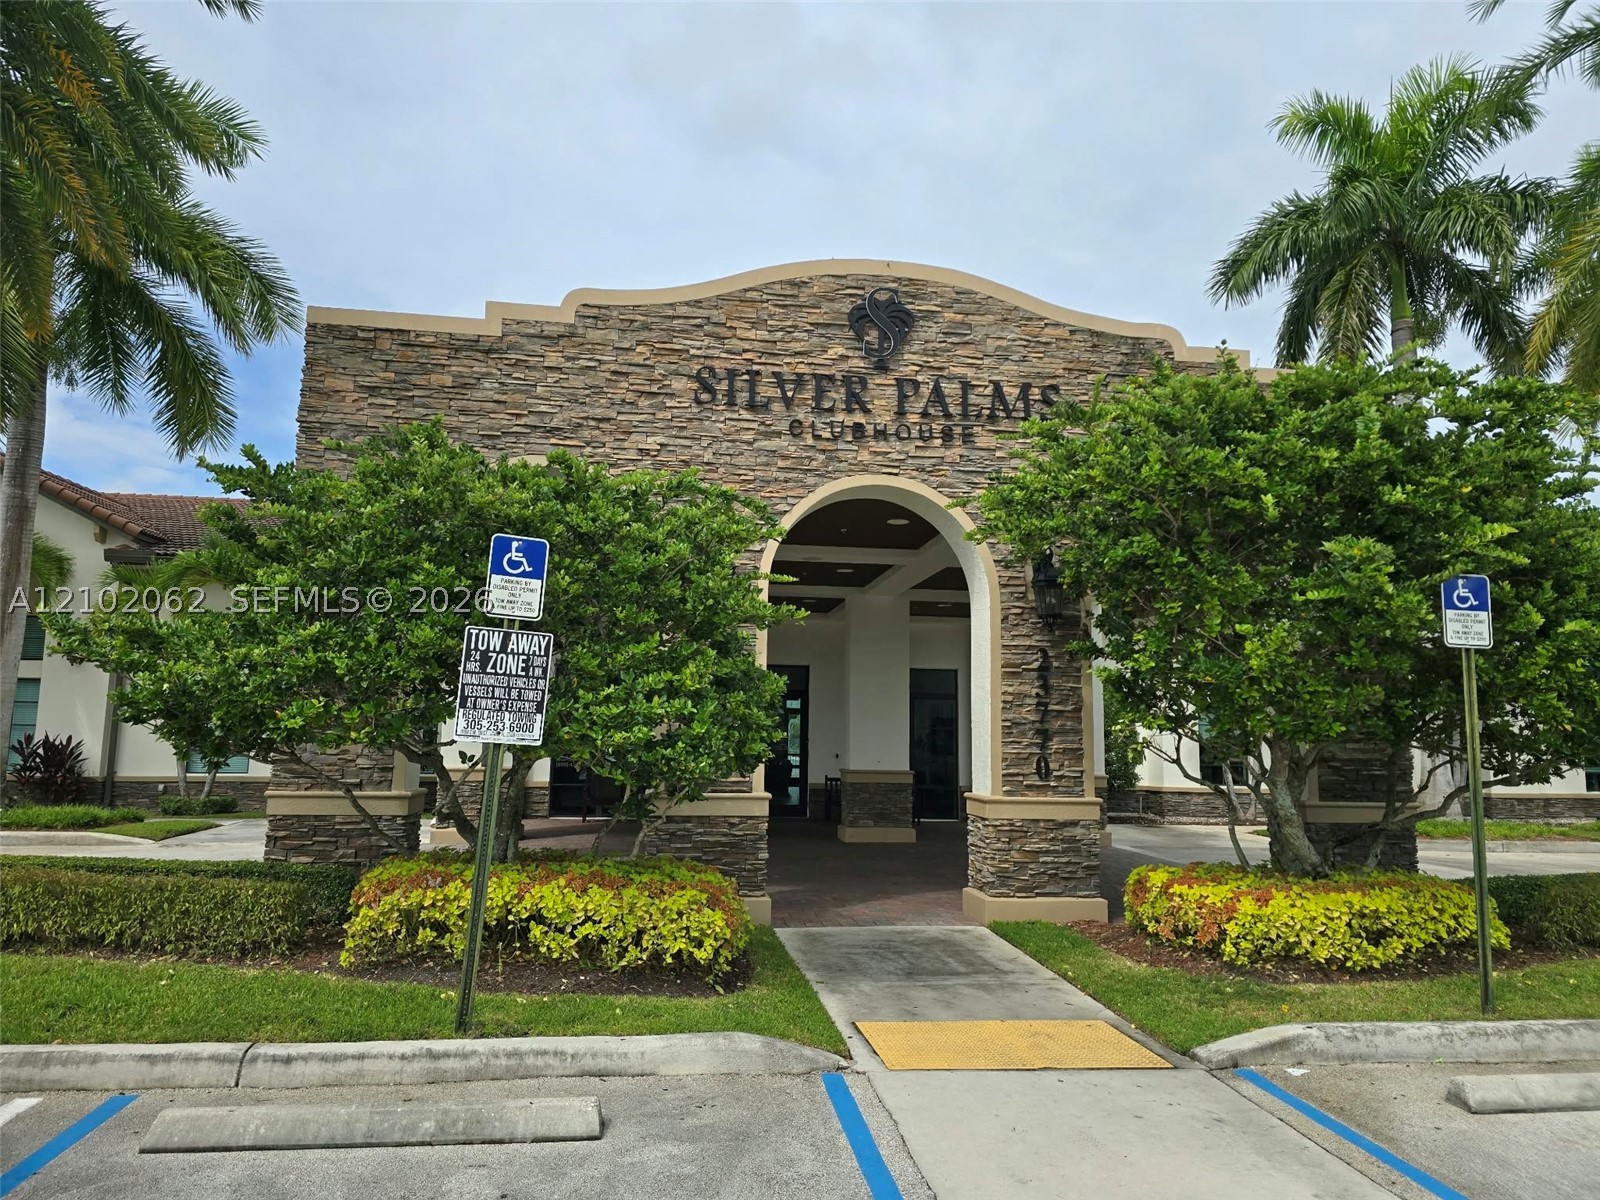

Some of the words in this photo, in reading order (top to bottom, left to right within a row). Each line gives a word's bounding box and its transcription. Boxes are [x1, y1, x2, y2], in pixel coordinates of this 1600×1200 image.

[694, 365, 872, 412] SILVER
[894, 375, 1061, 421] PALMS
[788, 418, 975, 443] CLUBHOUSE
[493, 584, 518, 592] DISABLED
[501, 578, 523, 586] PARKING
[470, 629, 503, 652] TOW
[507, 633, 549, 656] AWAY
[470, 650, 480, 661] 24
[529, 655, 533, 666] 7
[533, 656, 547, 667] DAYS
[466, 661, 481, 673] HRS.
[486, 652, 527, 676] ZONE
[528, 667, 533, 677] A
[463, 673, 508, 687] UNAUTHORIZED
[509, 676, 536, 689] VEHICLES
[537, 679, 545, 690] OR
[464, 685, 493, 698] VESSELS
[494, 687, 509, 699] WILL
[510, 689, 519, 700] BE
[521, 690, 542, 701] TOWED
[466, 697, 475, 708] AT
[476, 698, 506, 711] OWNER'S
[508, 700, 537, 713] EXPENSE
[462, 709, 506, 722] REGULATED
[508, 711, 537, 723] TOWING
[1034, 648, 1050, 780] 23770
